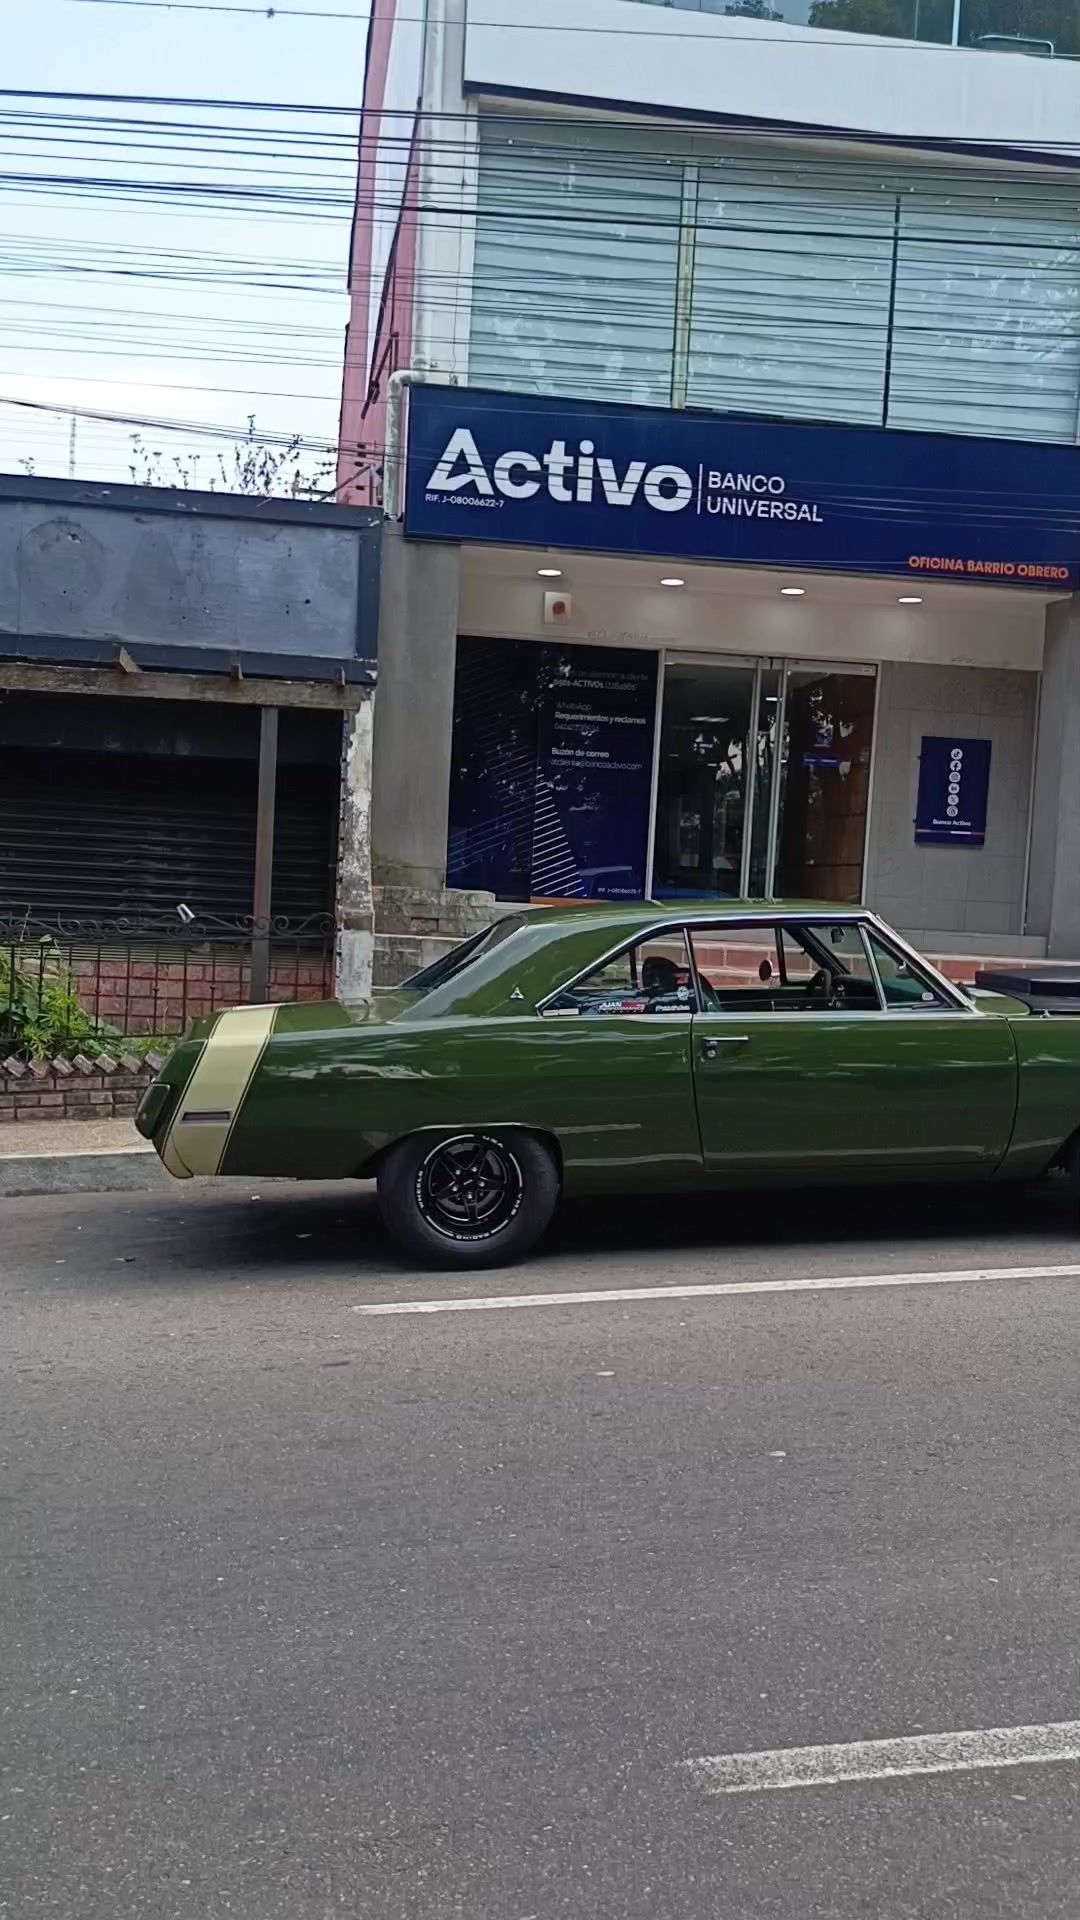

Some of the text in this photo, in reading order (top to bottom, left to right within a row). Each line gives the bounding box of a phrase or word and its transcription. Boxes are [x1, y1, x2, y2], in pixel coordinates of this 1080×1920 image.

[426, 428, 693, 512] Activo
[707, 471, 785, 495] BANCO
[442, 495, 505, 508] J-08006622-7
[707, 496, 823, 523] UNIVERSAL
[908, 555, 1069, 579] OFICINA BARRIO OBRERO
[555, 711, 608, 723] Requerimientos
[614, 716, 647, 725] reclamos
[585, 750, 610, 758] correo
